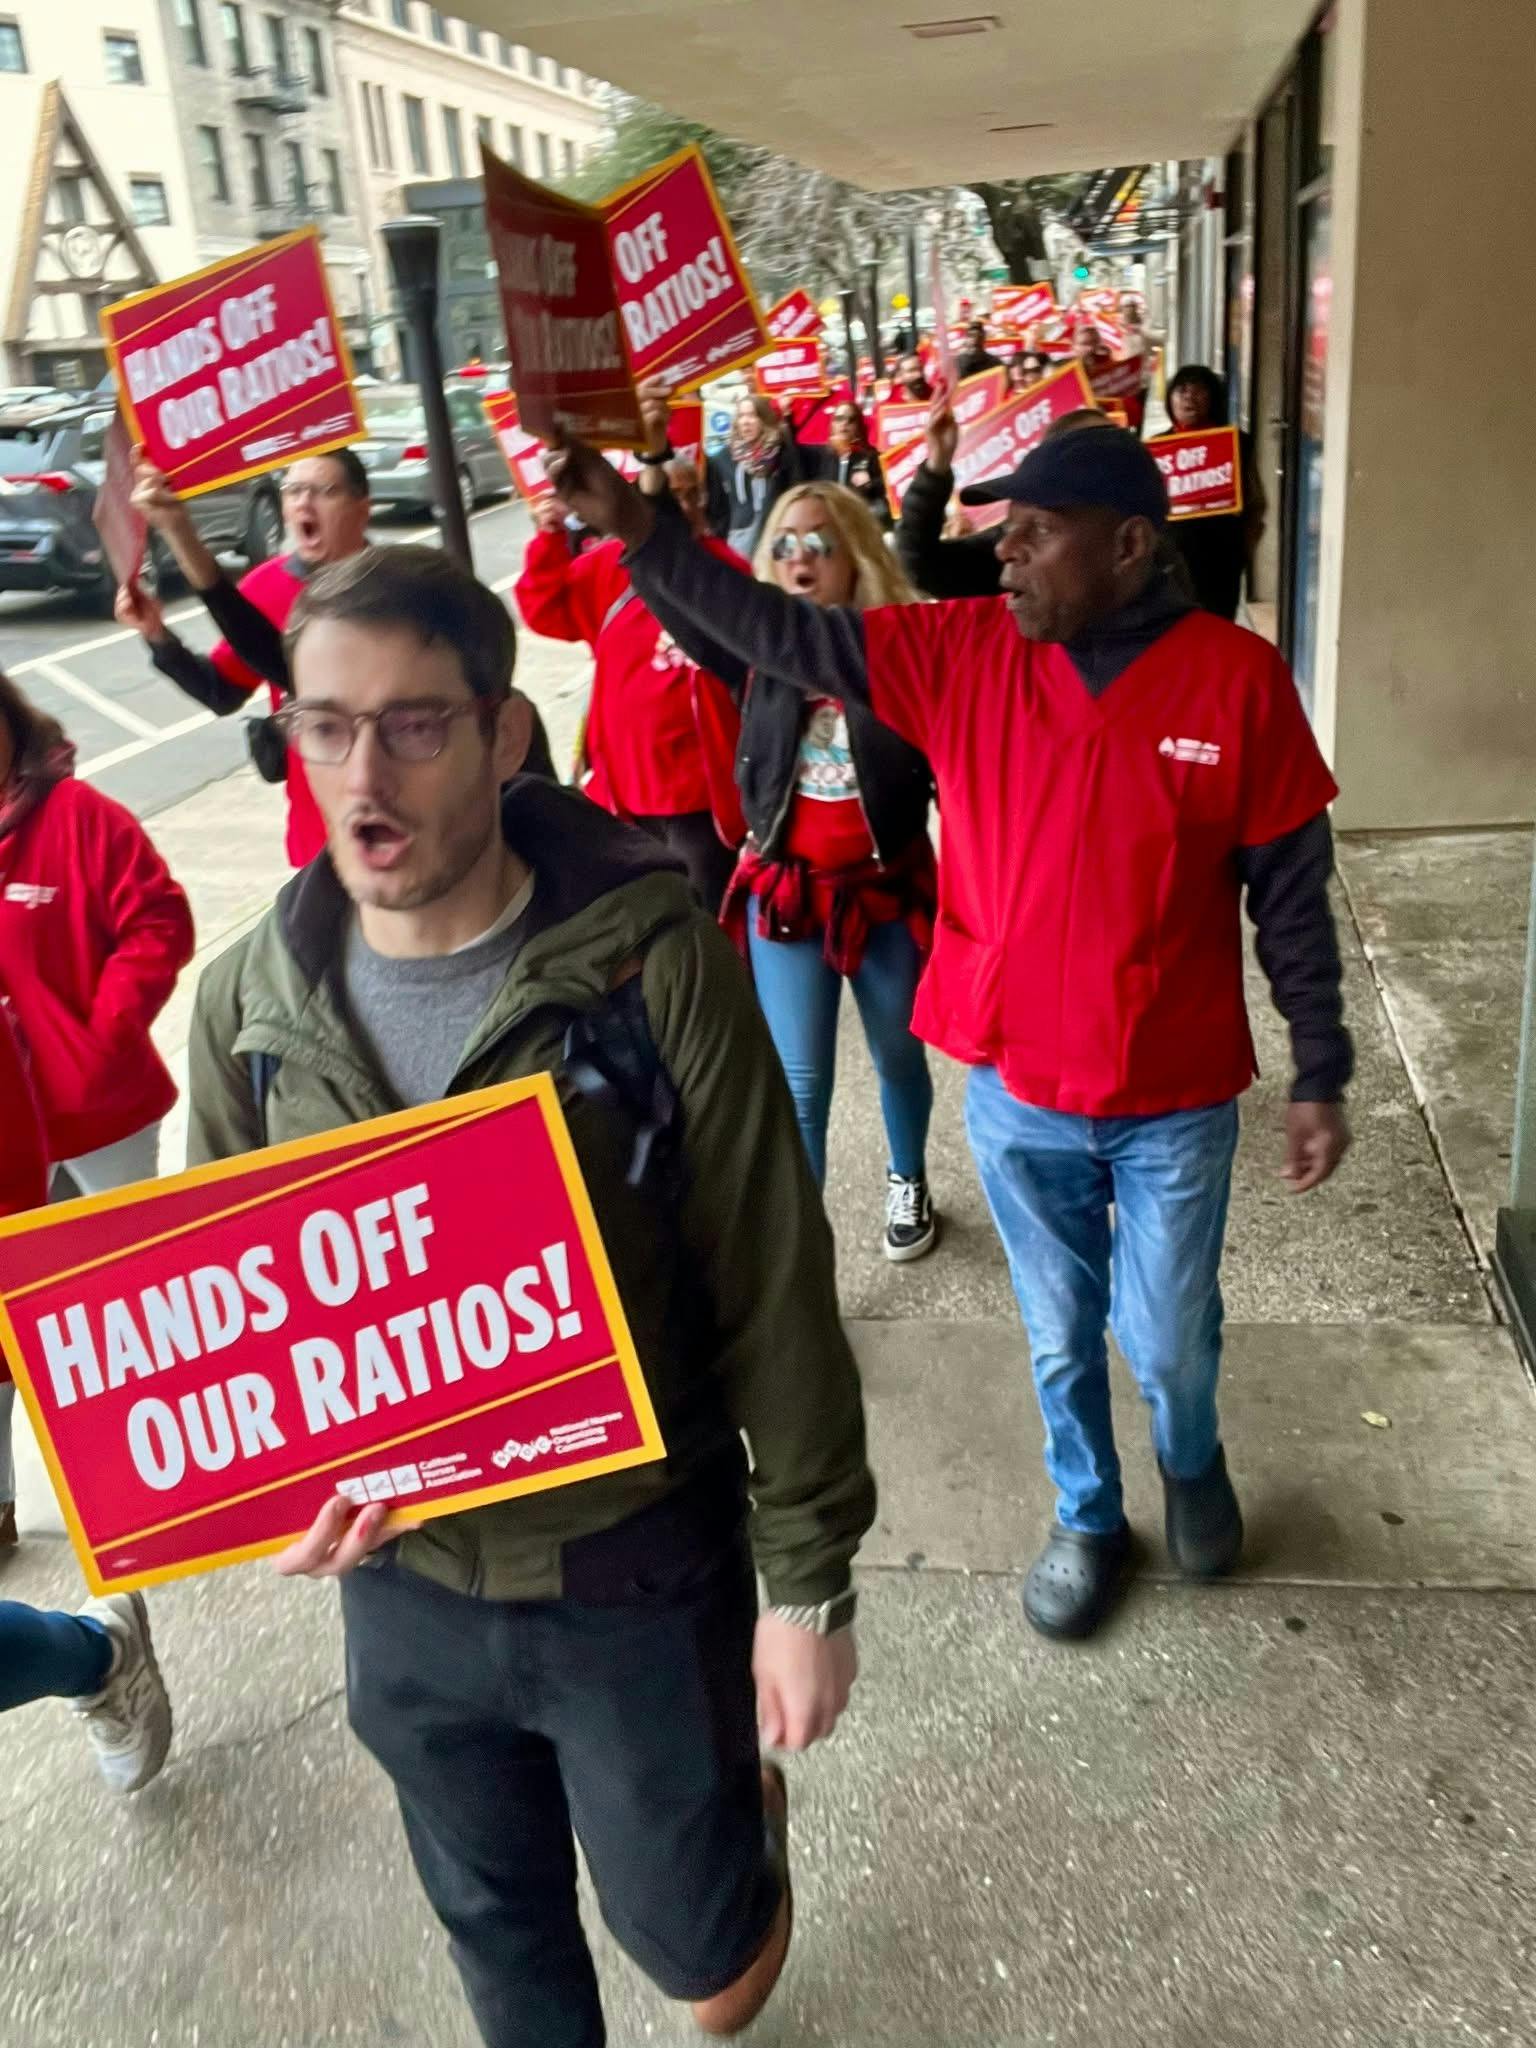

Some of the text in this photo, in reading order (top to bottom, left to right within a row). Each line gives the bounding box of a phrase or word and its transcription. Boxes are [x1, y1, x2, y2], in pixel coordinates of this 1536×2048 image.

[614, 212, 669, 283] OFF
[620, 236, 733, 353] RATIOS!
[123, 283, 277, 404] HANDS OFF
[158, 316, 337, 450] OUR RATIOS!
[1015, 398, 1051, 440] OFF
[1176, 445, 1208, 471] OFF
[1167, 461, 1233, 497] RATIOS!
[36, 1183, 435, 1408] HANDS OFF
[127, 1241, 583, 1491] OUR RATIOS!
